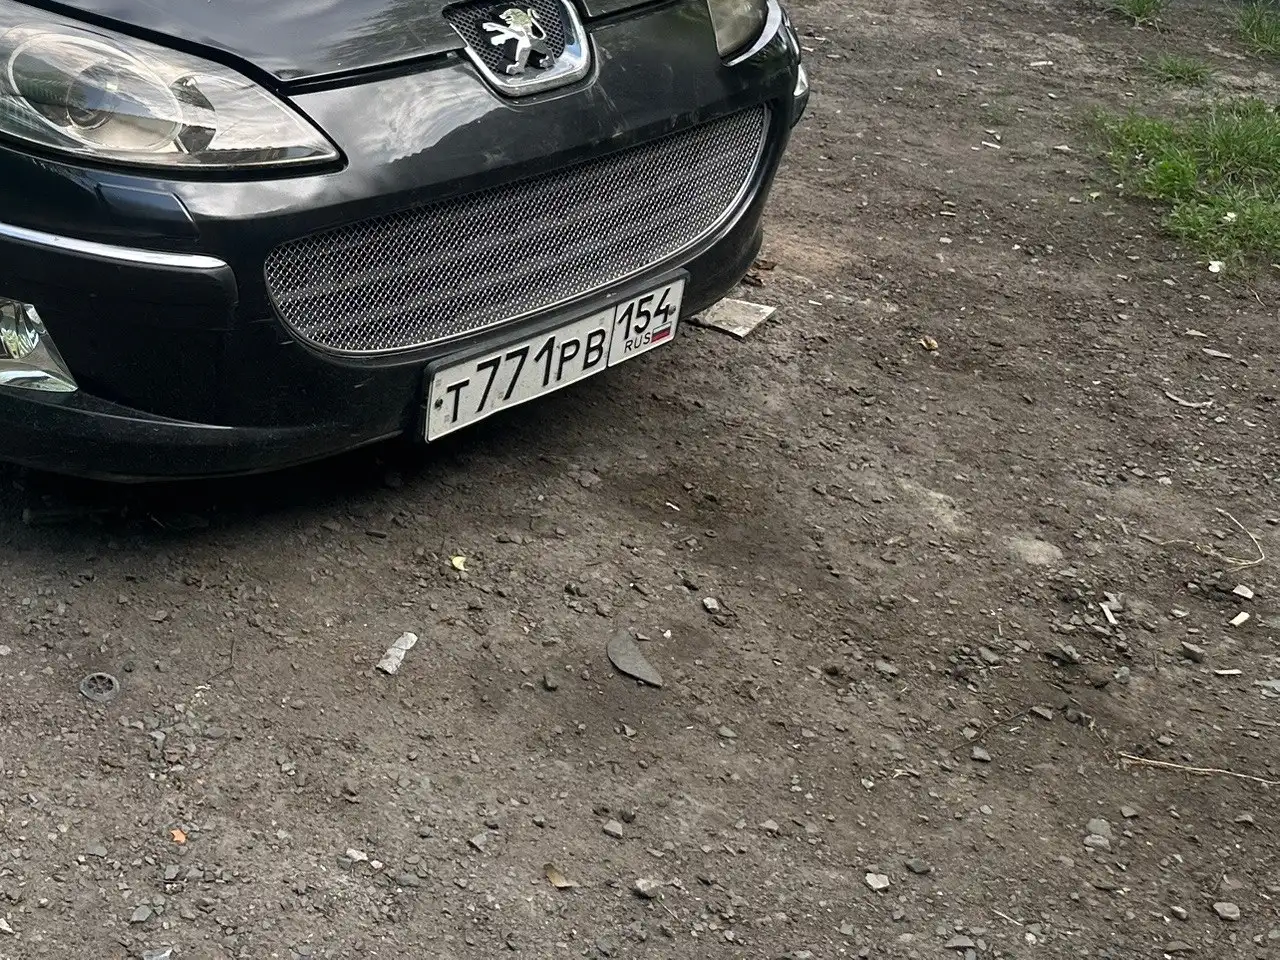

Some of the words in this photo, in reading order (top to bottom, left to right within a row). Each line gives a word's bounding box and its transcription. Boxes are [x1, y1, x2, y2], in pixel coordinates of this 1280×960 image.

[446, 328, 607, 424] Т771РВ
[617, 287, 671, 340] 154
[624, 332, 651, 353] RUS
